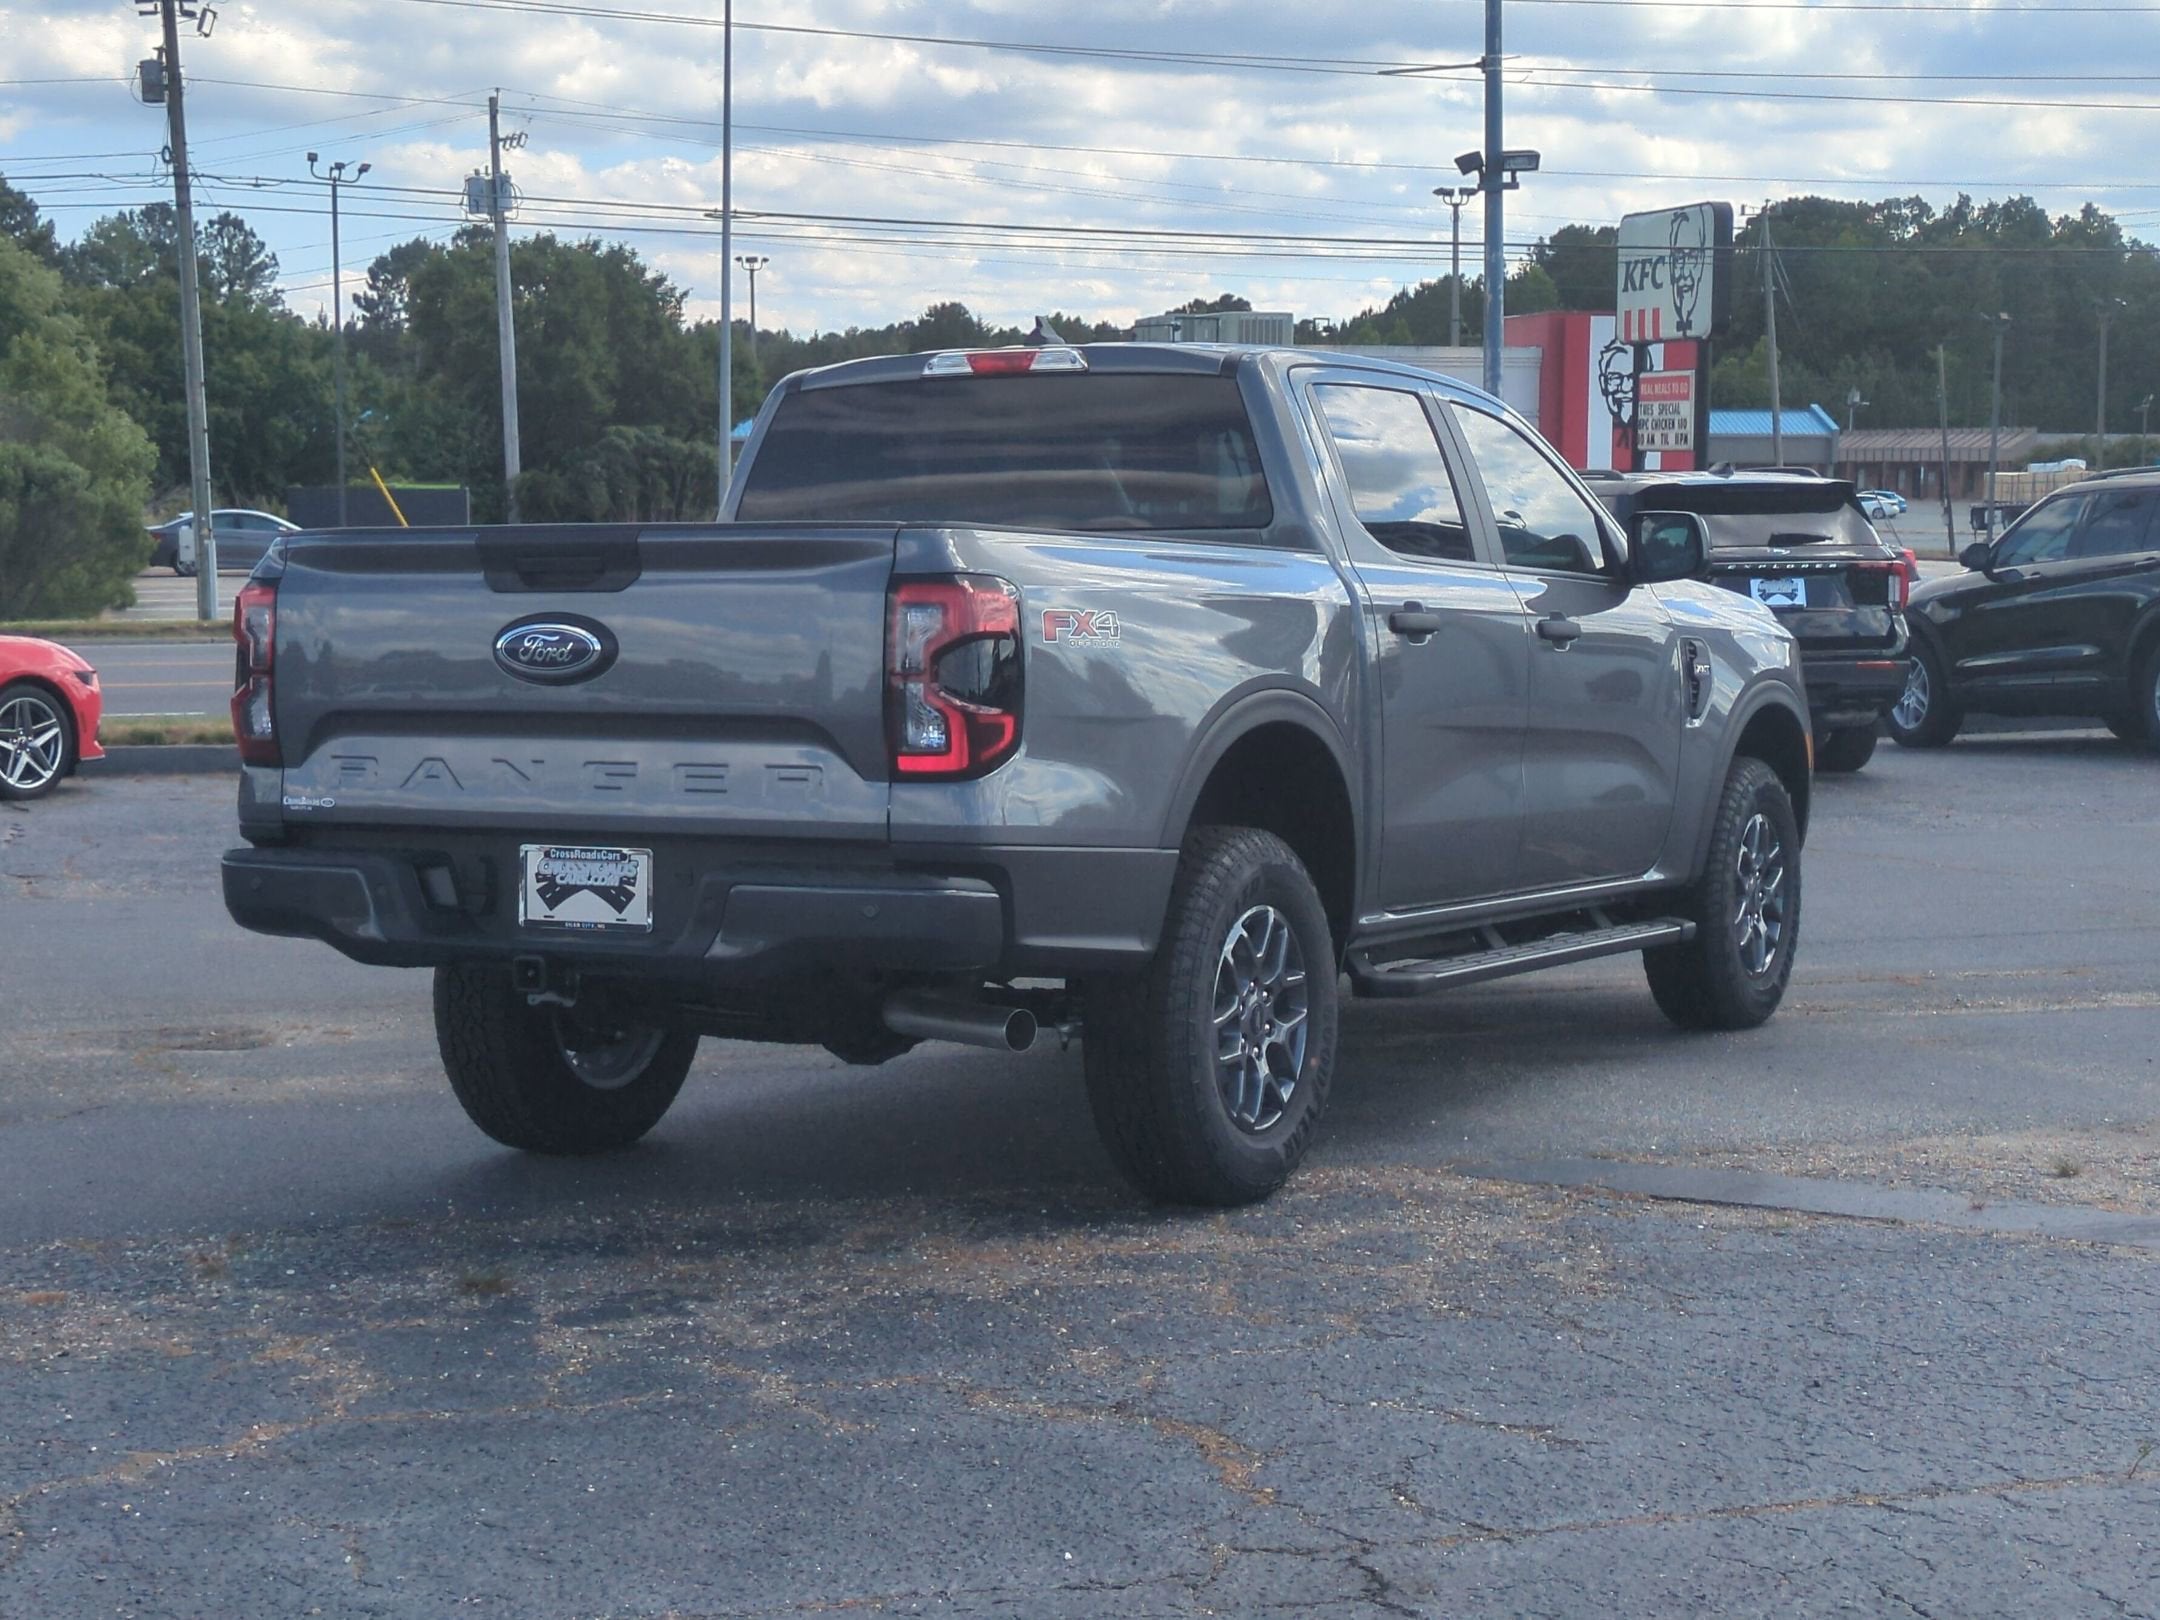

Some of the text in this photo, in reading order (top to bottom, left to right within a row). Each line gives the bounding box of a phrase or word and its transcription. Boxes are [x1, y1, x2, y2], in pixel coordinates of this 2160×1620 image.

[1622, 255, 1666, 293] KFC
[1672, 383, 1679, 394] TO
[1640, 402, 1681, 416] TUES SPECIAL
[1651, 418, 1675, 430] CHICKEN
[1042, 608, 1121, 643] FX4
[519, 634, 574, 662] Ford
[1069, 639, 1091, 649] OFF
[330, 754, 826, 798] RANGER
